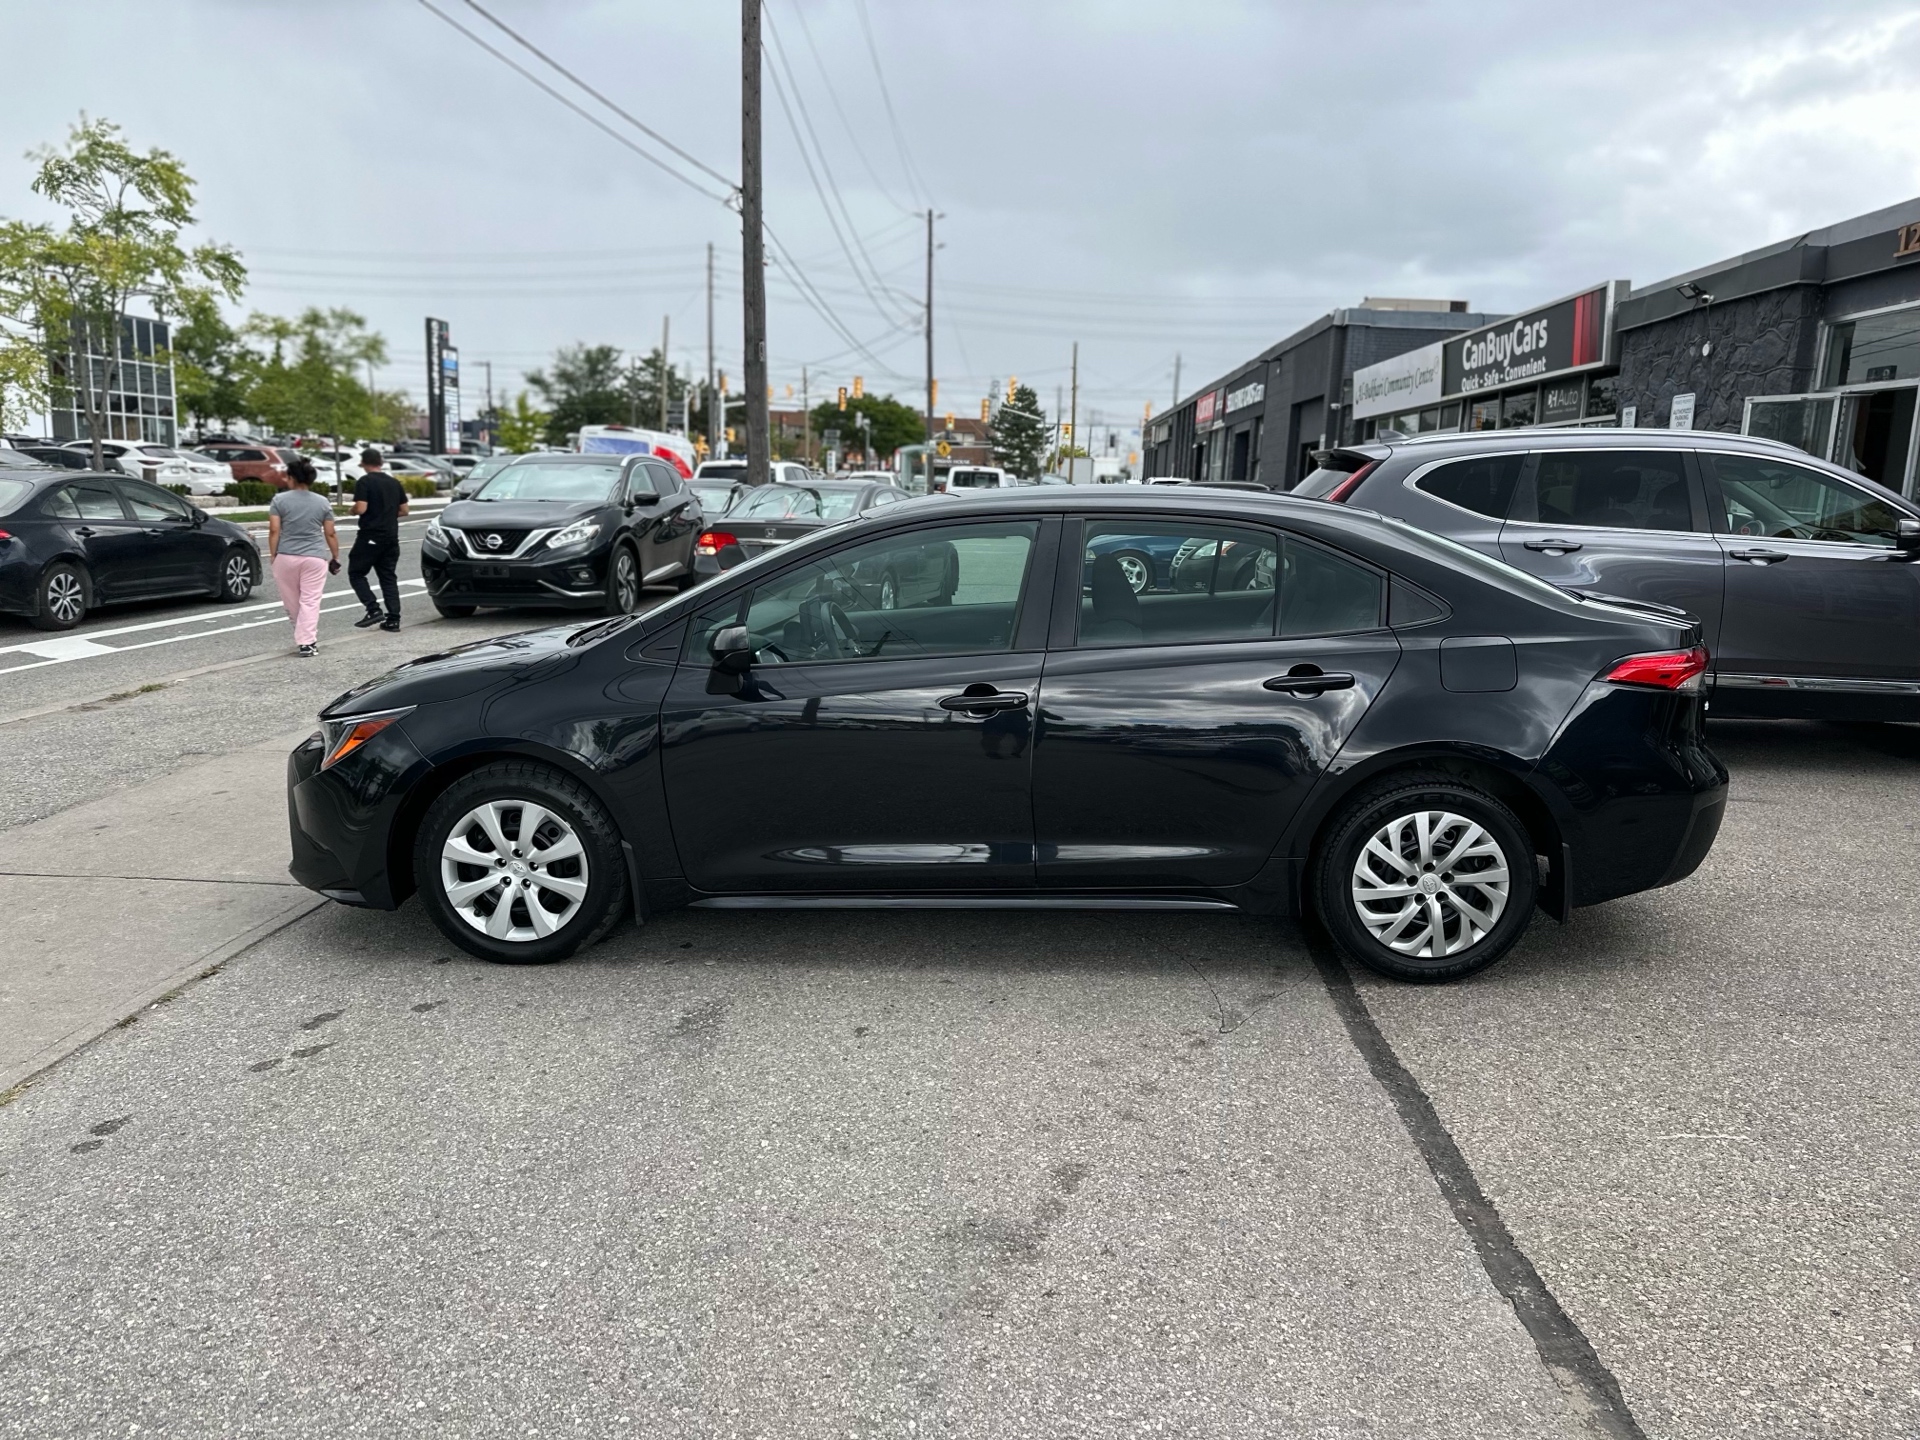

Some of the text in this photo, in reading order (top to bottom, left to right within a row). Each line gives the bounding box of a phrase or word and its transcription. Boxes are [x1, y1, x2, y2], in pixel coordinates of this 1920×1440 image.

[1462, 319, 1548, 371] CanBuyCars
[1383, 370, 1415, 397] Community
[1461, 374, 1479, 393] Quick
[1483, 369, 1499, 387] Safe
[1504, 356, 1547, 381] Convenient
[1558, 388, 1579, 406] Auto
[1363, 793, 1463, 828] NEXEN
